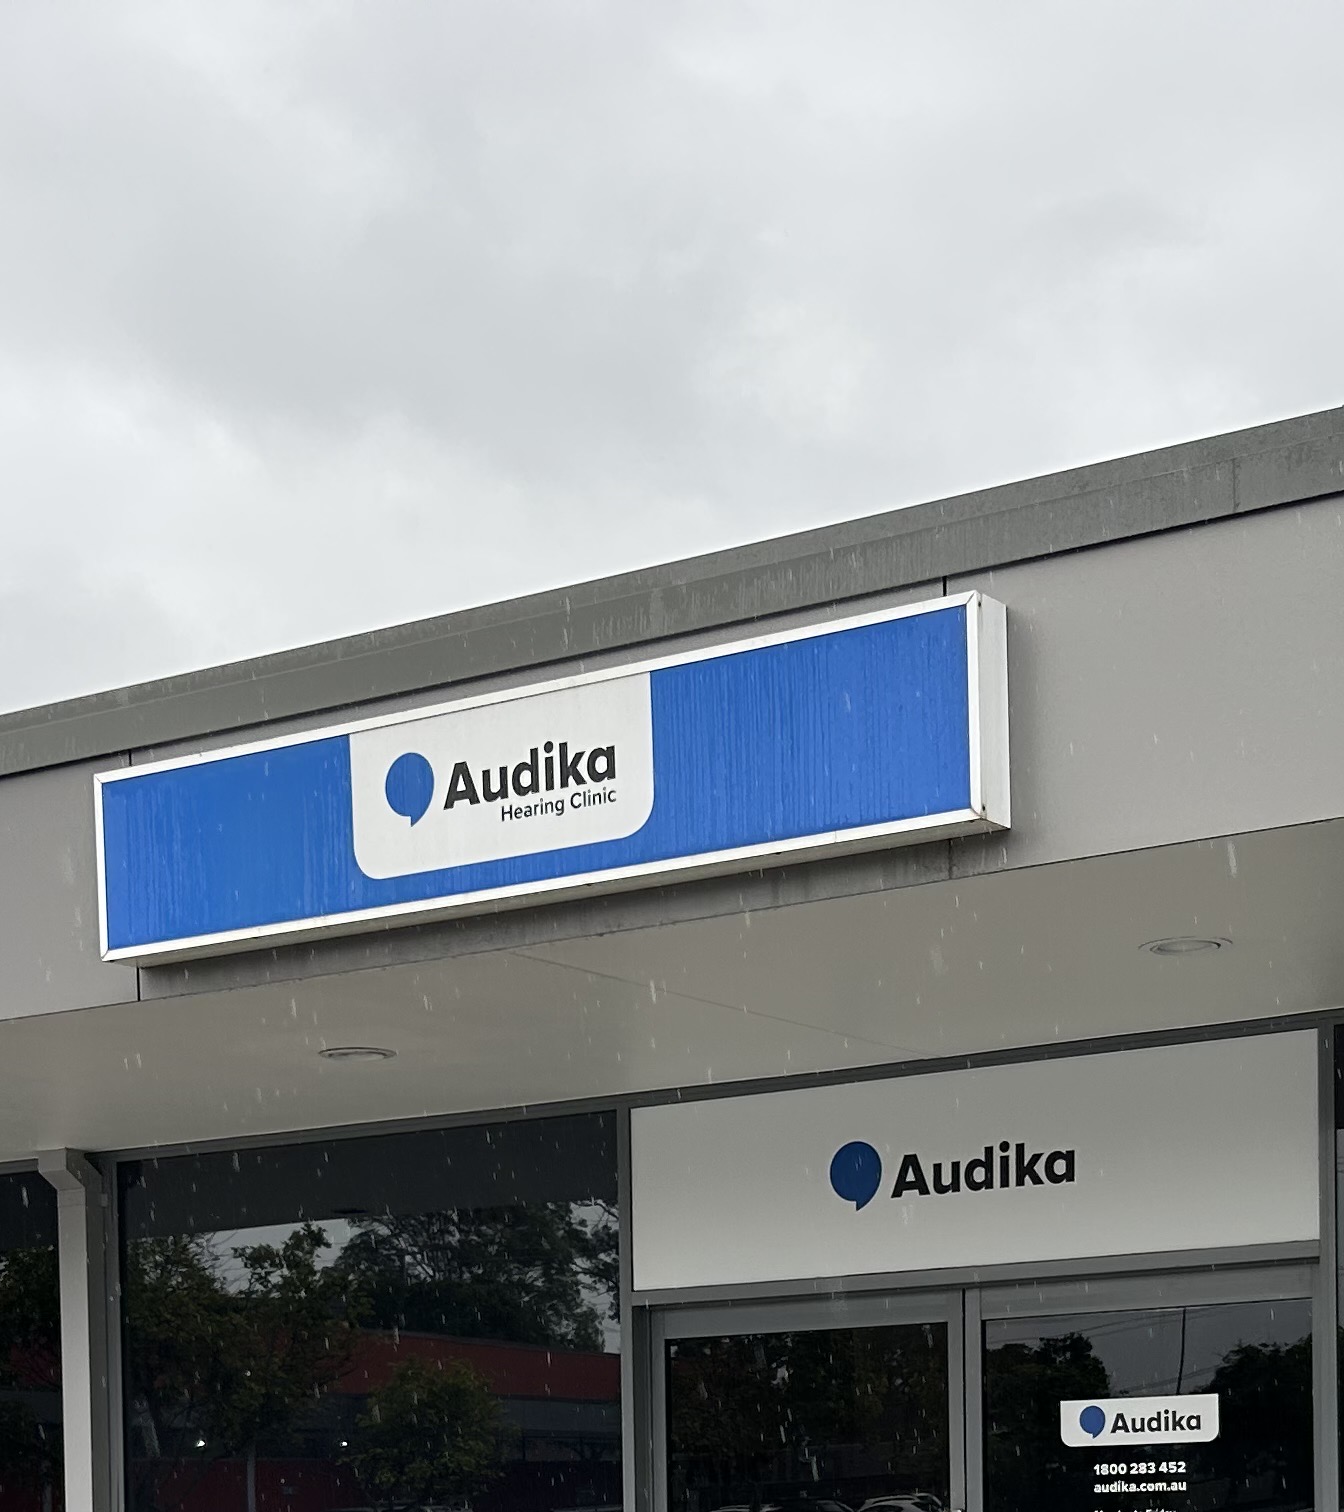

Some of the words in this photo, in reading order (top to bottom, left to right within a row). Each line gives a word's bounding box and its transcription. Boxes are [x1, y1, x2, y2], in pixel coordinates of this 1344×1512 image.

[443, 740, 616, 810] Audika
[501, 798, 565, 822] Hearing
[570, 787, 617, 810] Clinic
[890, 1140, 1075, 1199] Audika
[1110, 1409, 1202, 1433] Audika
[1093, 1463, 1127, 1475] 1800
[1129, 1462, 1156, 1475] 283
[1158, 1461, 1187, 1474] 452
[1093, 1480, 1187, 1493] audika.com.au
